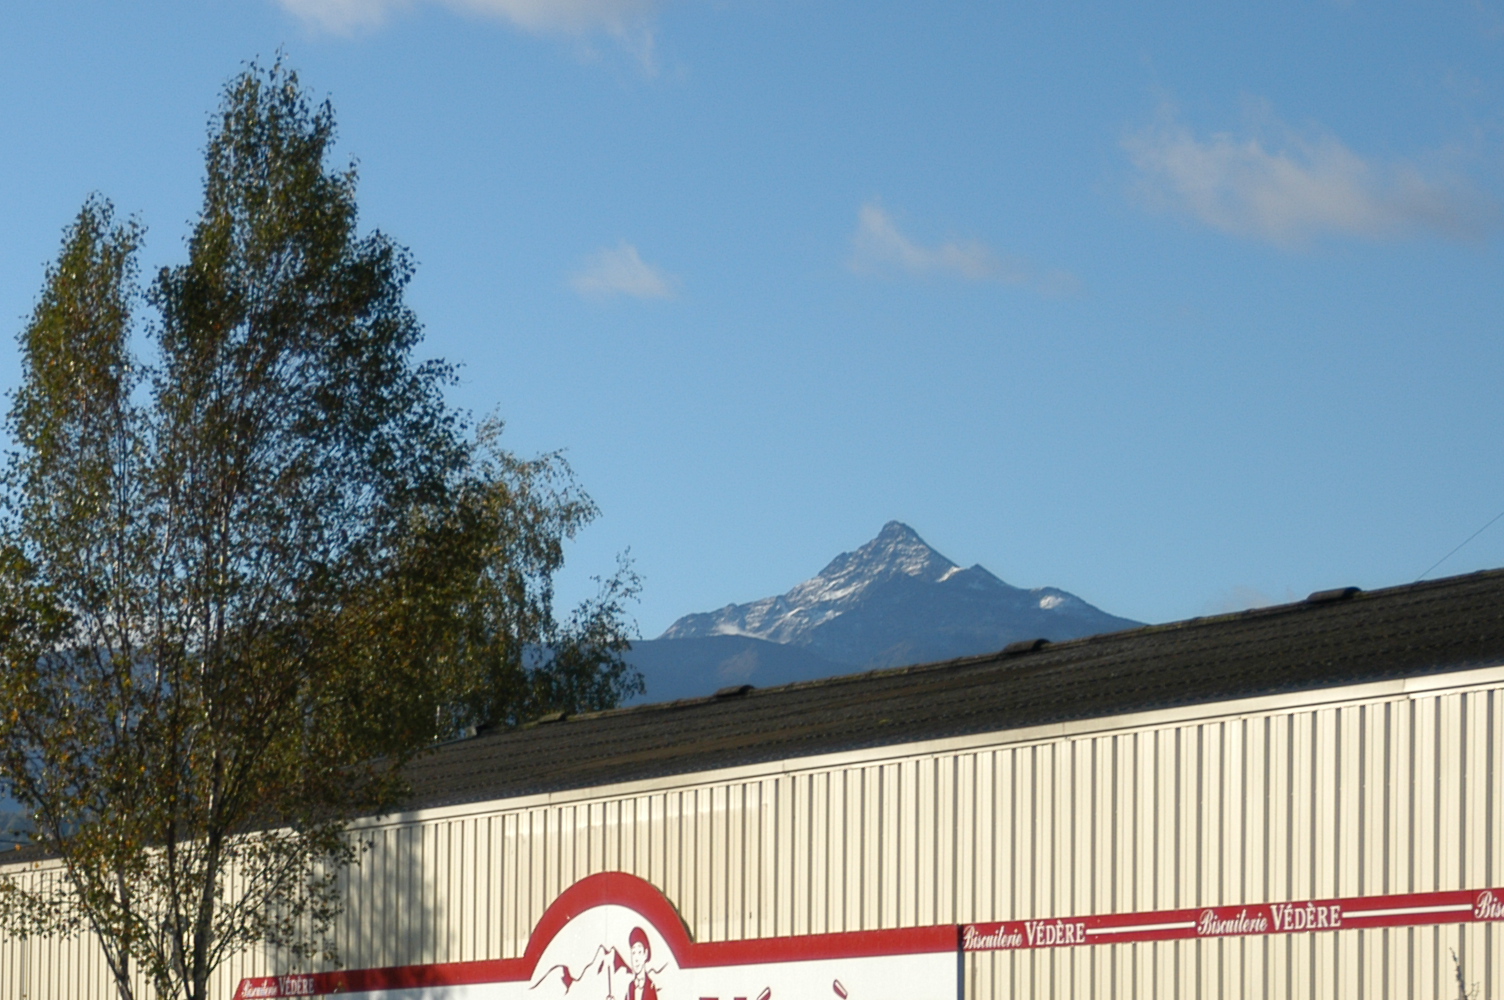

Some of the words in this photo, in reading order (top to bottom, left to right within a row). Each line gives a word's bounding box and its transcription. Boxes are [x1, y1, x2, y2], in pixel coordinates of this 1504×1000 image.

[1474, 890, 1504, 918] Bis
[1024, 919, 1086, 946] VÉDÈRE
[1197, 908, 1268, 935] Biscuiterie
[1270, 902, 1341, 931] VÉDÈRE
